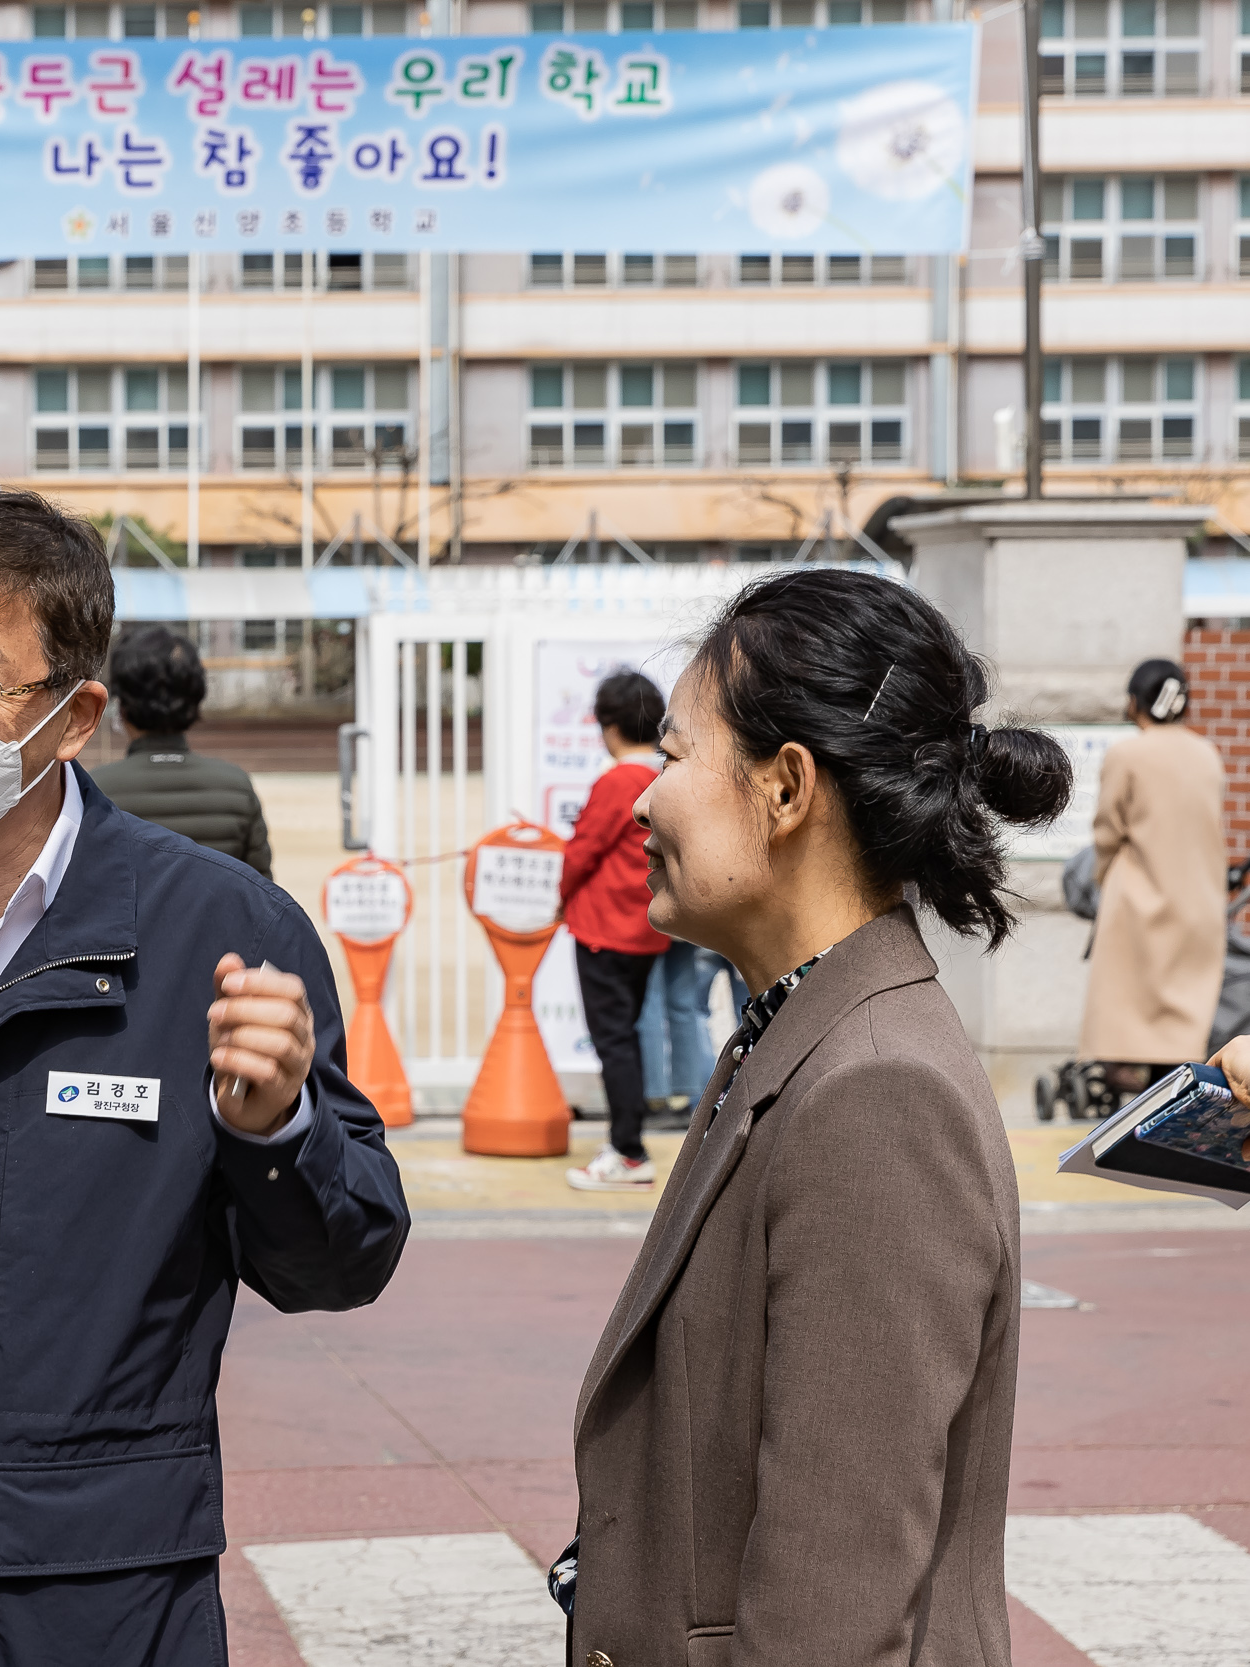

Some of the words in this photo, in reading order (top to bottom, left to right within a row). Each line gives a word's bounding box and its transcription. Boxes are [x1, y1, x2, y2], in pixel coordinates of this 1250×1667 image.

[176, 57, 355, 116] 설레는
[395, 56, 514, 110] 우리
[549, 50, 661, 110] 학교
[53, 132, 163, 187] 나는
[203, 129, 252, 187] 참
[289, 124, 497, 190] 좋아요!
[86, 1081, 149, 1099] 김경호
[93, 1100, 140, 1113] 광진구청장
